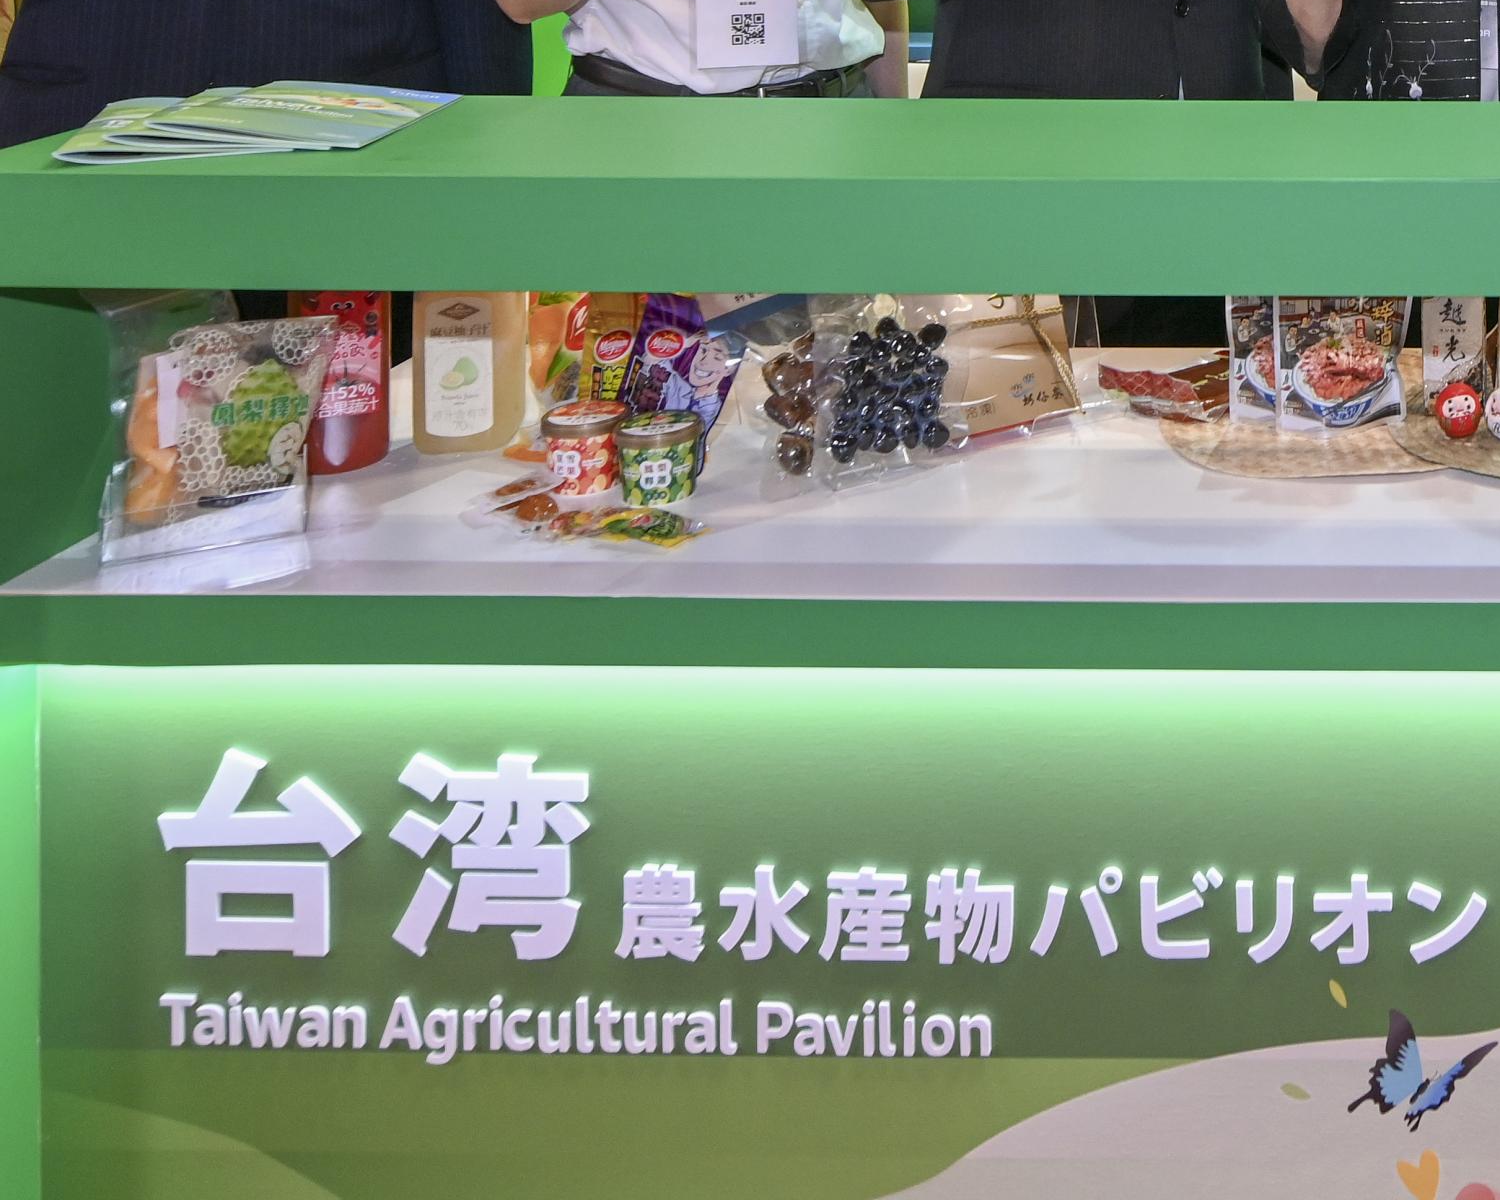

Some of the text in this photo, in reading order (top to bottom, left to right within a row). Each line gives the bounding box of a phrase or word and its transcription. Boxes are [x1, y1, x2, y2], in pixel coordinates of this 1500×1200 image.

[157, 748, 1490, 967] 台湾 農水産物パビリオン
[159, 991, 994, 1065] Taiwan Agricultural Pavilion
